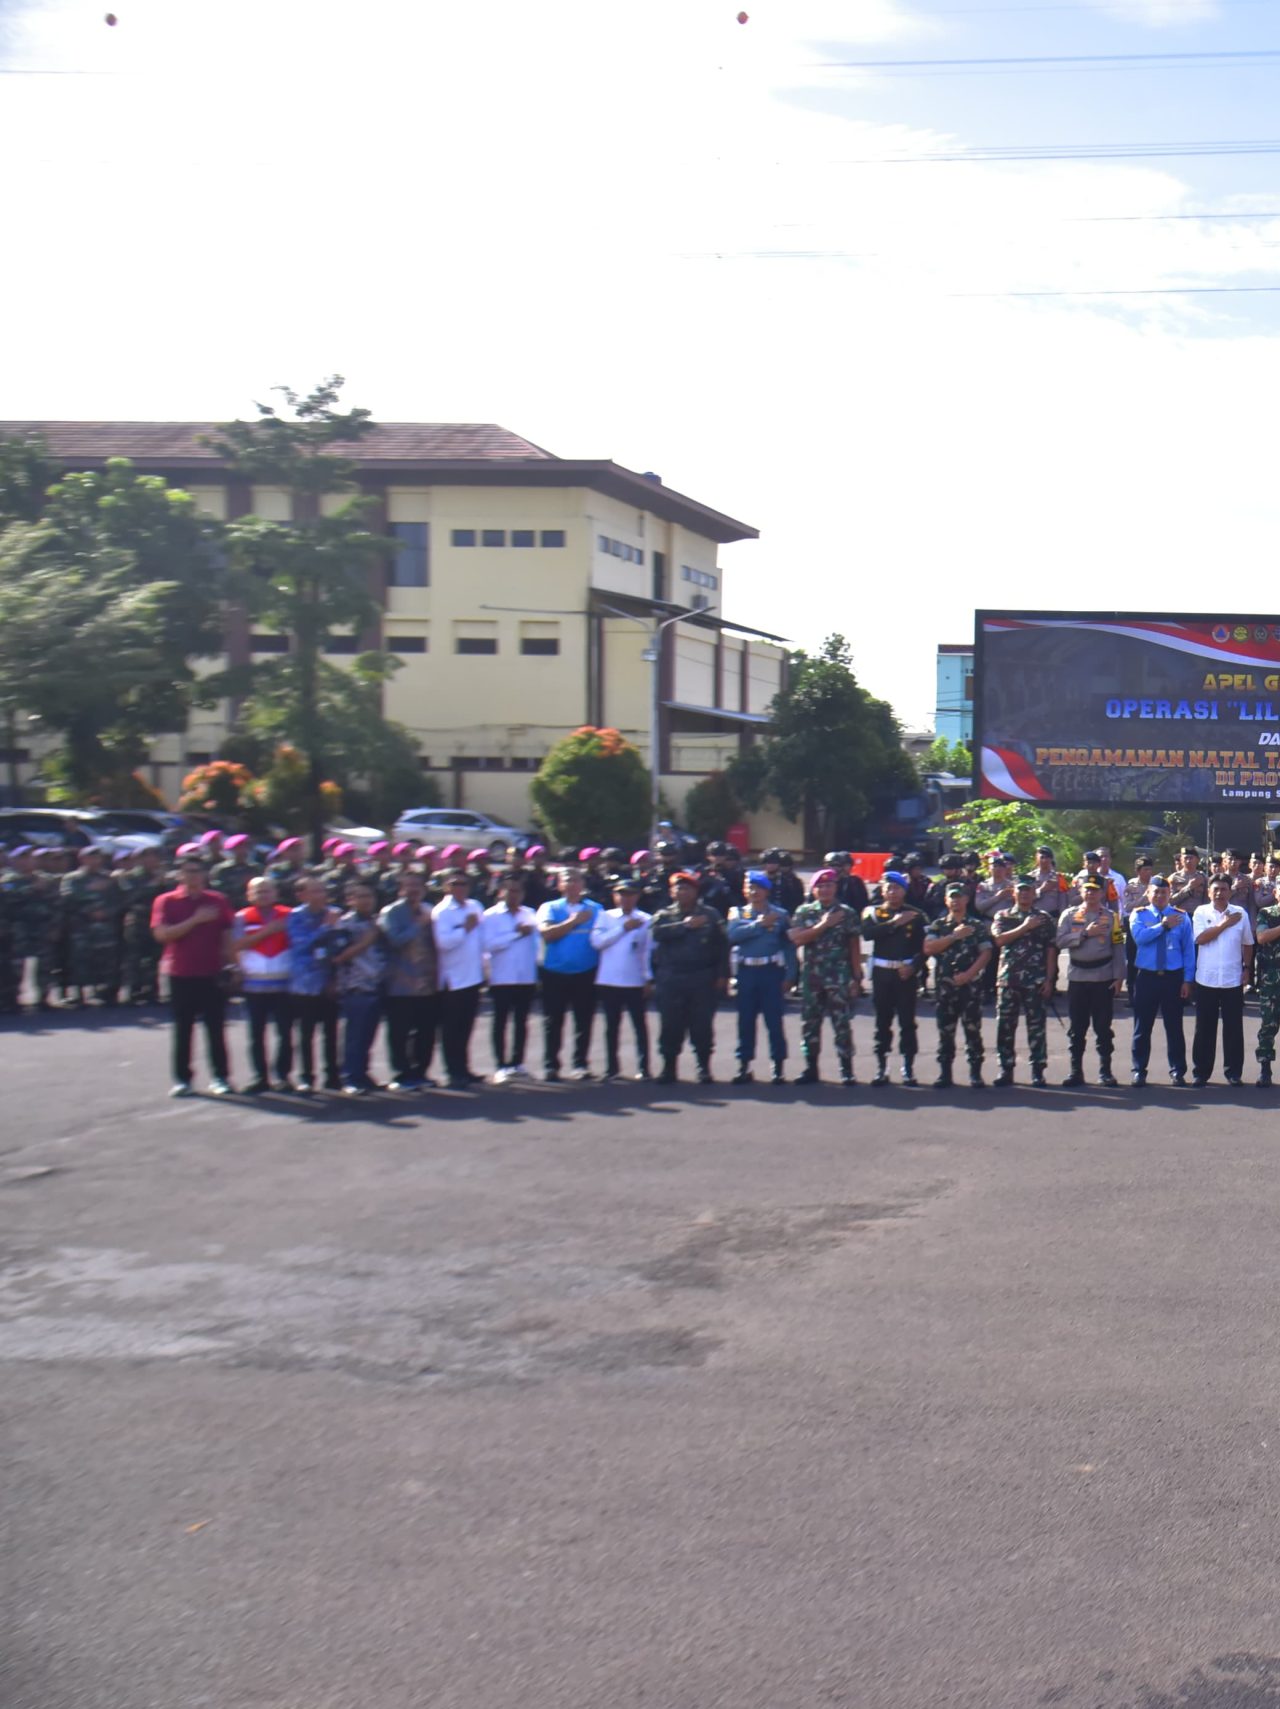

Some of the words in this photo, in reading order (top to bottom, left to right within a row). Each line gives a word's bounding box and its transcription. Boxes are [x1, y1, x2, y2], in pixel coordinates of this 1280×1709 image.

[1203, 674, 1256, 691] APEL
[1105, 699, 1218, 720] OPERASI
[1035, 747, 1185, 768] PENGAMANAN
[1188, 749, 1260, 769] NATAL
[1215, 770, 1235, 785] DI
[1222, 788, 1271, 800] Lampung
